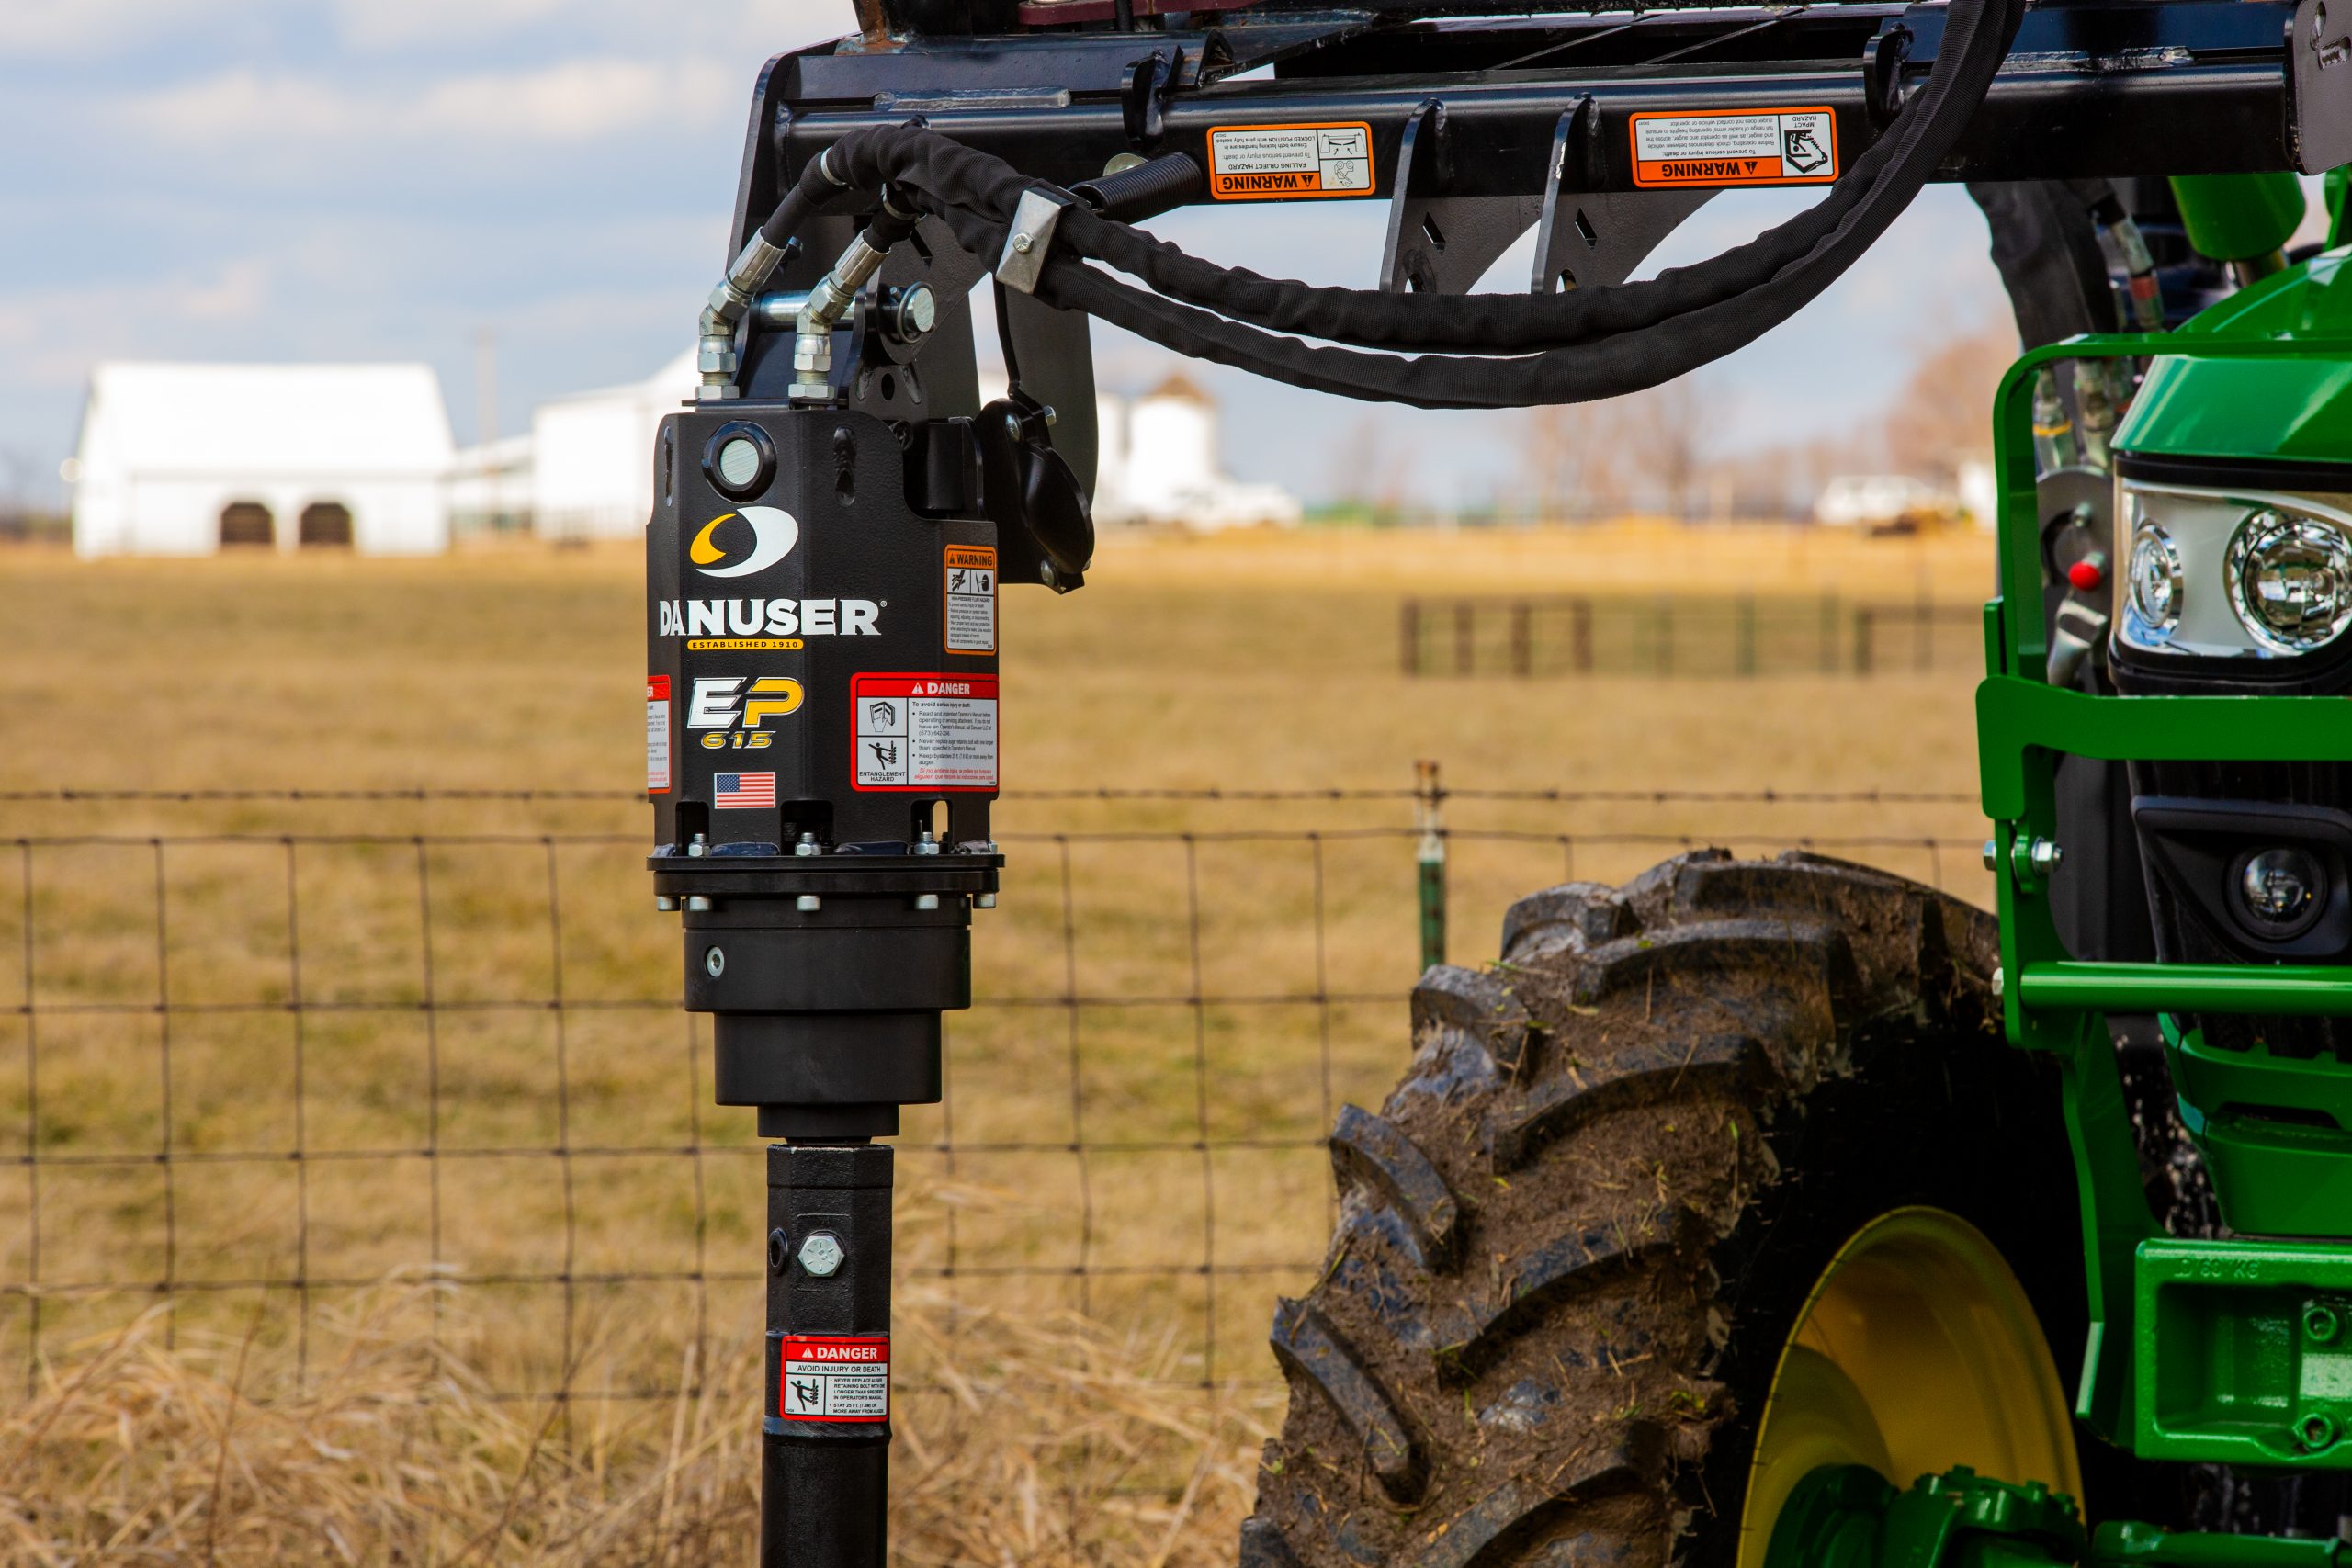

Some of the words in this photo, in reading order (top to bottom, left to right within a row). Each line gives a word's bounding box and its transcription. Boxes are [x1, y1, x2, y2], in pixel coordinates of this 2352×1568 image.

[1662, 162, 1740, 177] WARNING
[1223, 175, 1297, 190] WARNING
[957, 554, 993, 566] WARNING
[692, 640, 768, 649] ESTABLISHED
[772, 640, 798, 649] 1910
[927, 682, 970, 695] DANGER
[687, 677, 805, 728] EP
[700, 730, 777, 749] 615
[2233, 1259, 2259, 1278] KG
[817, 1347, 877, 1359] DANGER
